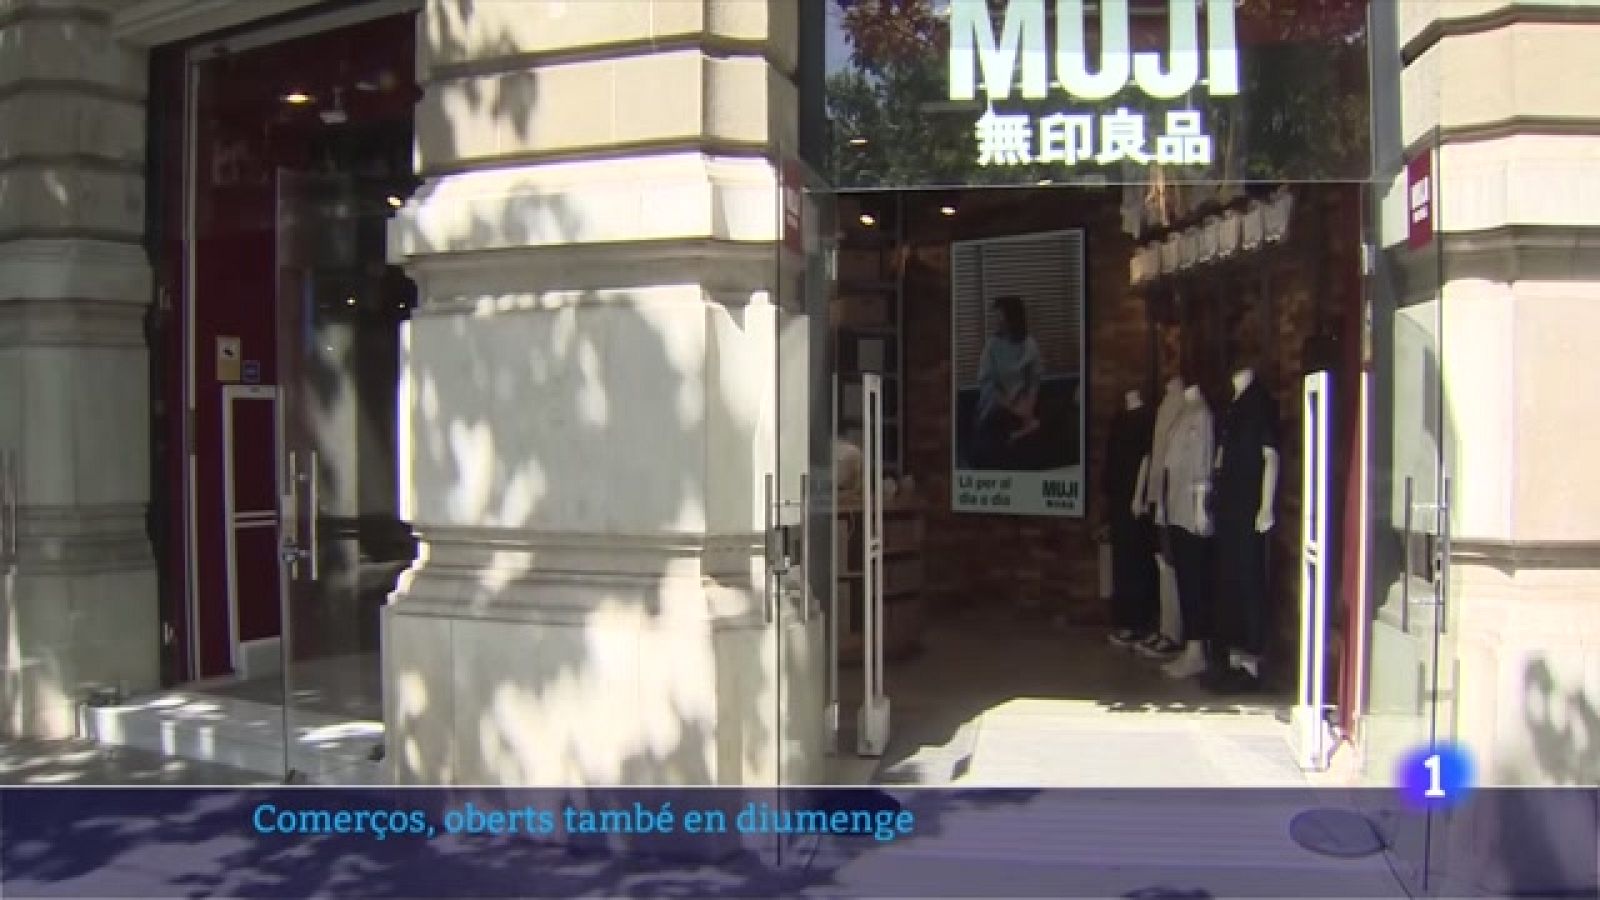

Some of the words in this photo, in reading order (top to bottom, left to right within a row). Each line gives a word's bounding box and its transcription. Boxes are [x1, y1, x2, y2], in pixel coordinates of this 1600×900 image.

[949, 0, 1239, 100] MUJI
[975, 107, 1212, 166] 無印良品
[1042, 479, 1079, 499] MUJI
